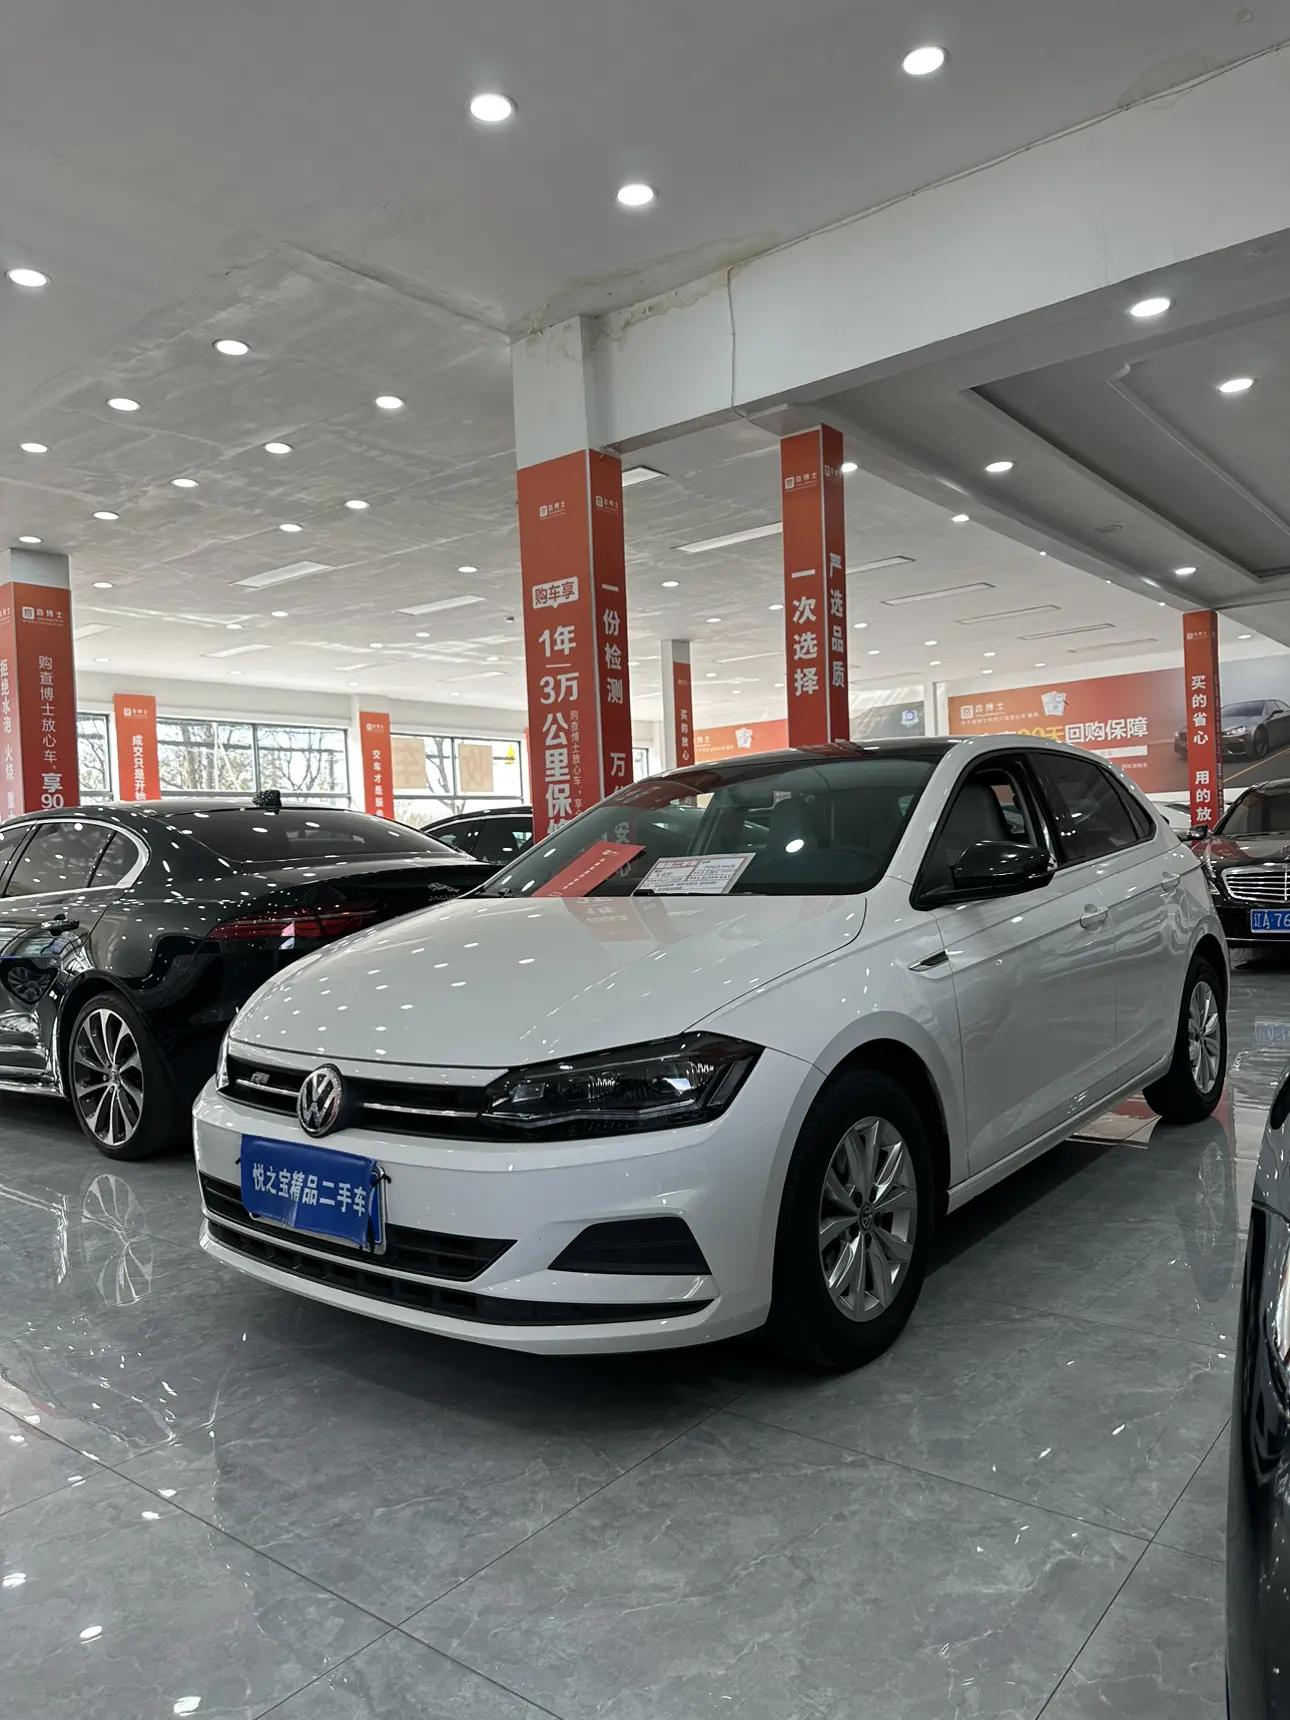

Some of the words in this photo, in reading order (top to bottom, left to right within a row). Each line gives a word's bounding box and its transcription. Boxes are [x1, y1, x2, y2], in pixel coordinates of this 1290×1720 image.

[535, 580, 576, 605] 购车享
[829, 552, 845, 688] 严选品质
[538, 624, 577, 657] 1年
[602, 584, 623, 705] 一份检测
[791, 568, 819, 696] 一次选择
[539, 671, 579, 704] 3万
[1191, 675, 1209, 745] 买的省心
[252, 1162, 367, 1218] 悦之宝精品二手车
